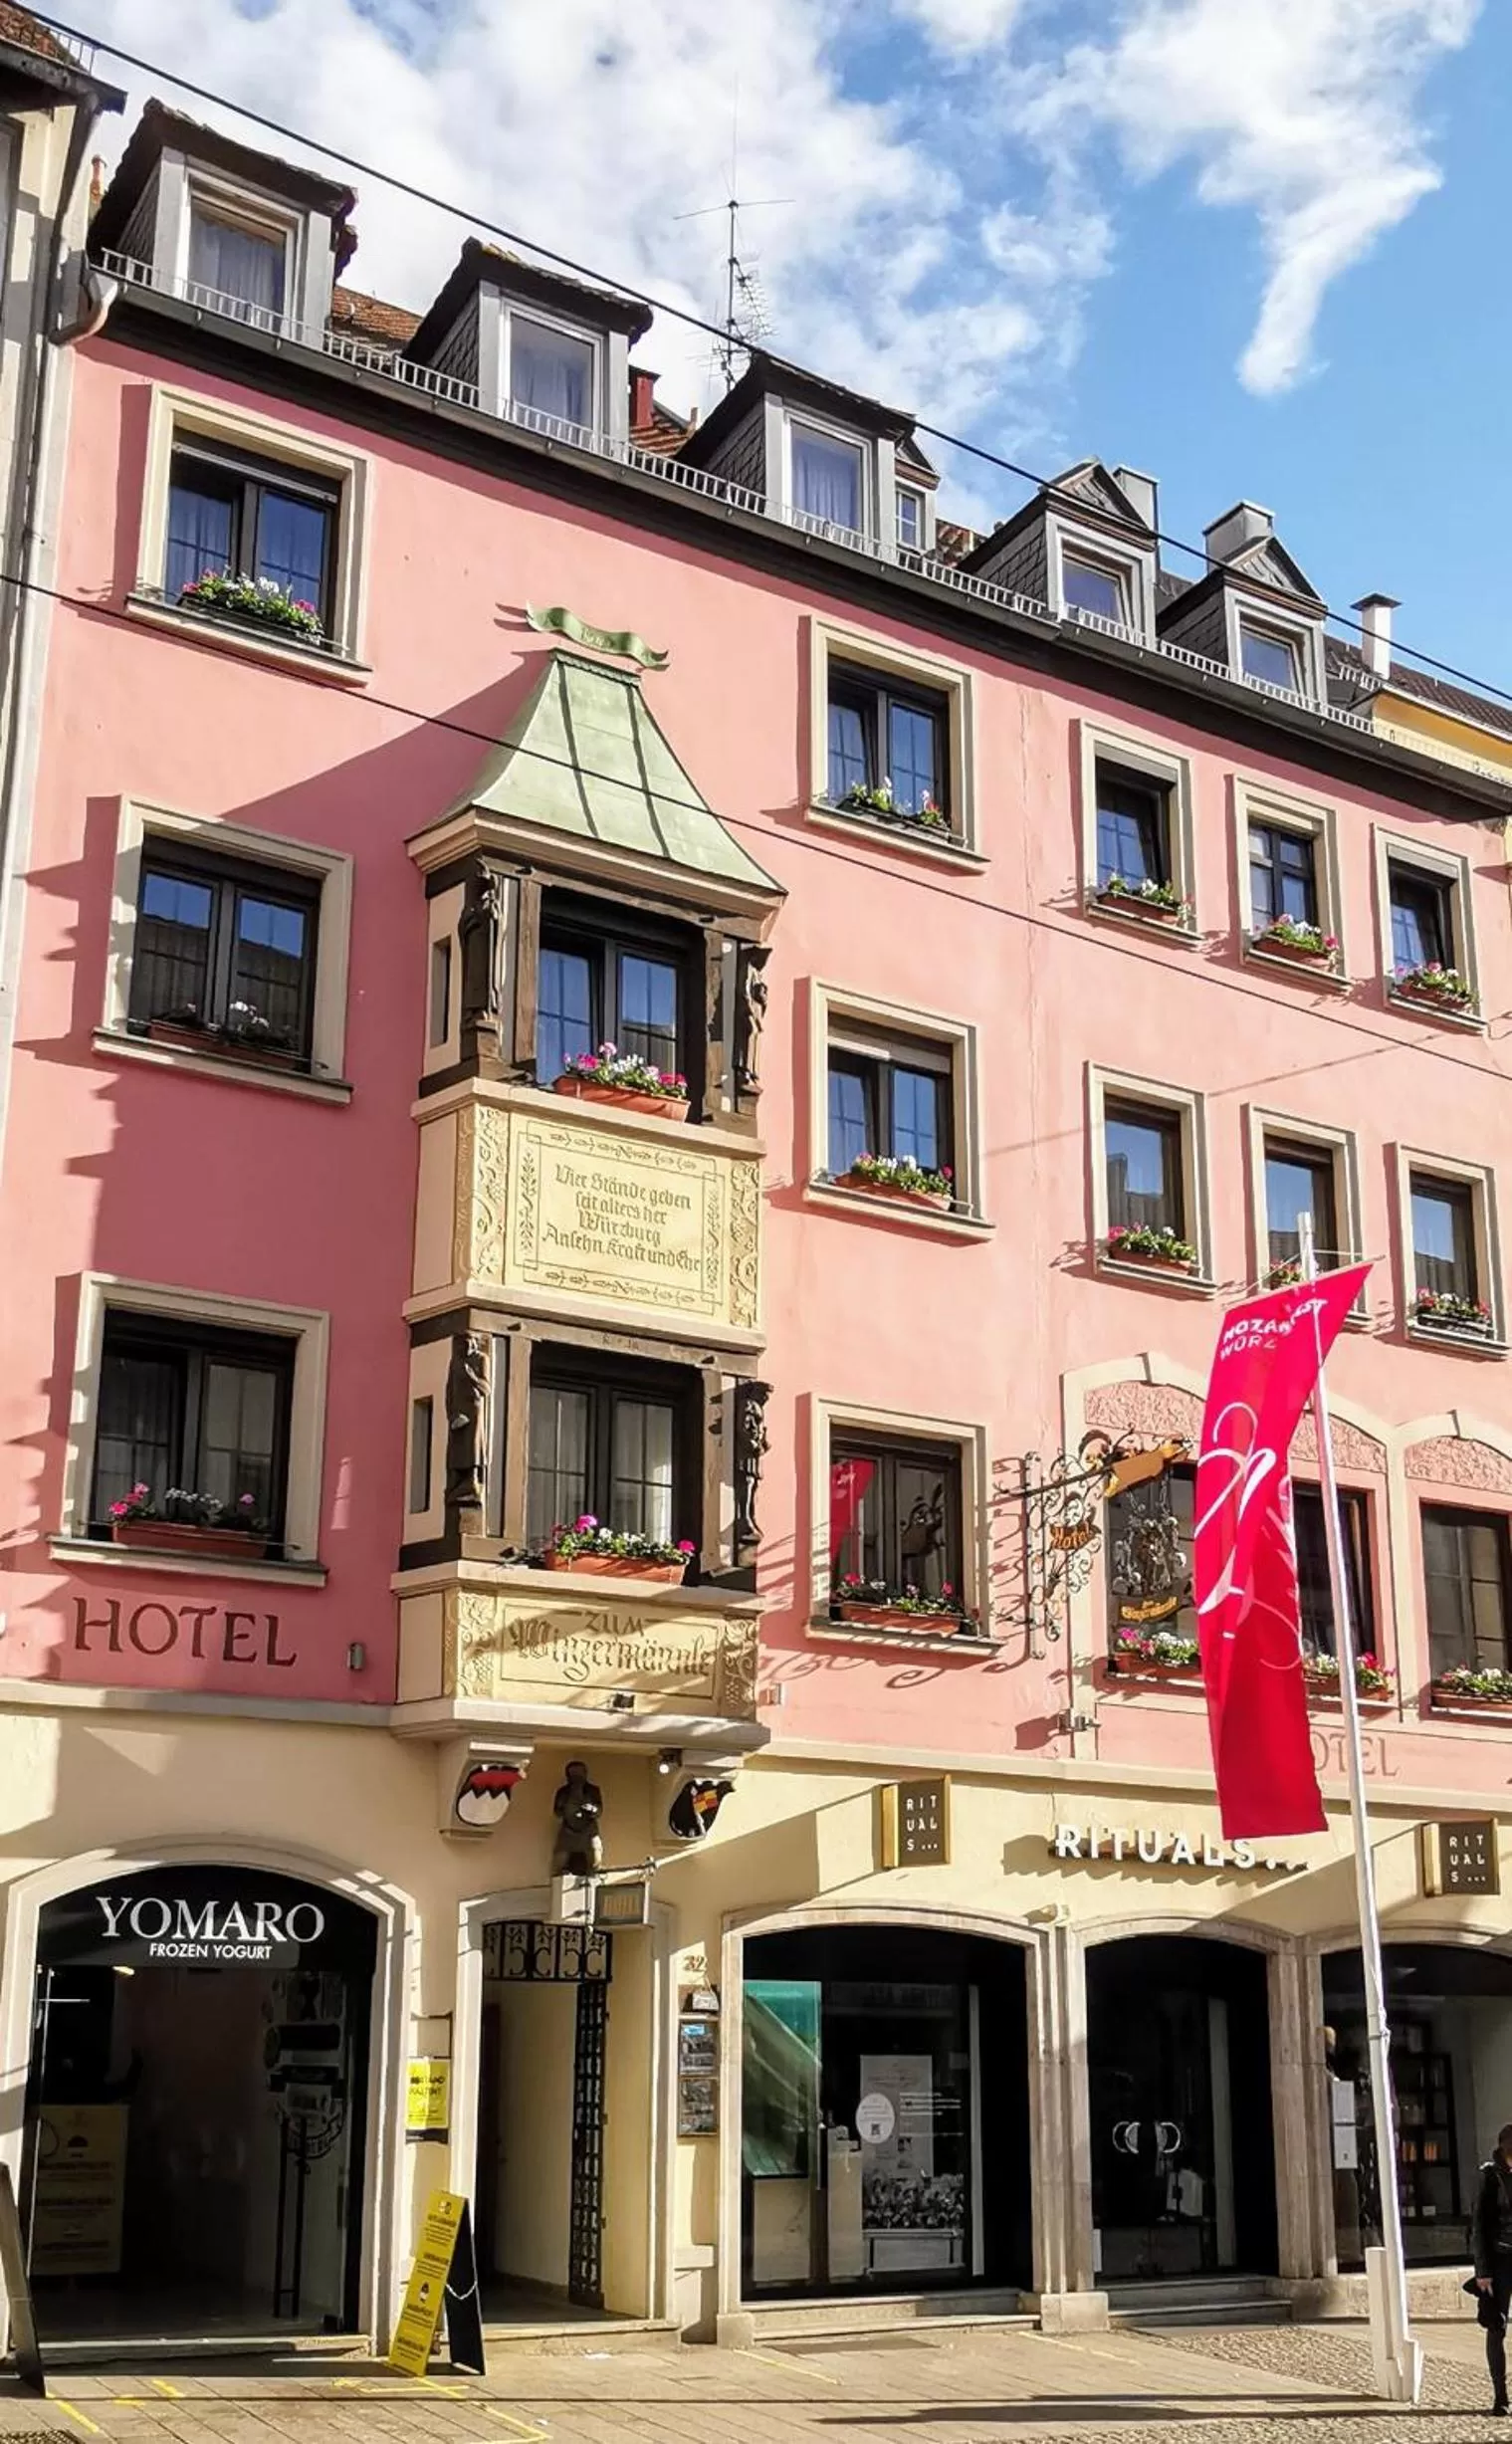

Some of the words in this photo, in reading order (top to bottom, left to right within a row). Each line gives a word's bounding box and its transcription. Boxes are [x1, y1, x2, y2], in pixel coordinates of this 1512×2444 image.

[591, 1173, 646, 1203] Stände
[649, 1188, 692, 1211] geben
[642, 1205, 668, 1225] her
[578, 1209, 662, 1248] Würzburg
[647, 1249, 676, 1268] und
[72, 1597, 298, 1667] HOTEL
[1309, 1730, 1401, 1777] OTEL
[906, 1794, 938, 1811] RIT
[906, 1816, 939, 1832] UAL
[1448, 1834, 1484, 1849] RIT
[1449, 1853, 1486, 1867] UAL
[96, 1896, 325, 1943] YOMARO
[149, 1942, 209, 1958] FROZEN
[213, 1944, 273, 1960] YOGURT
